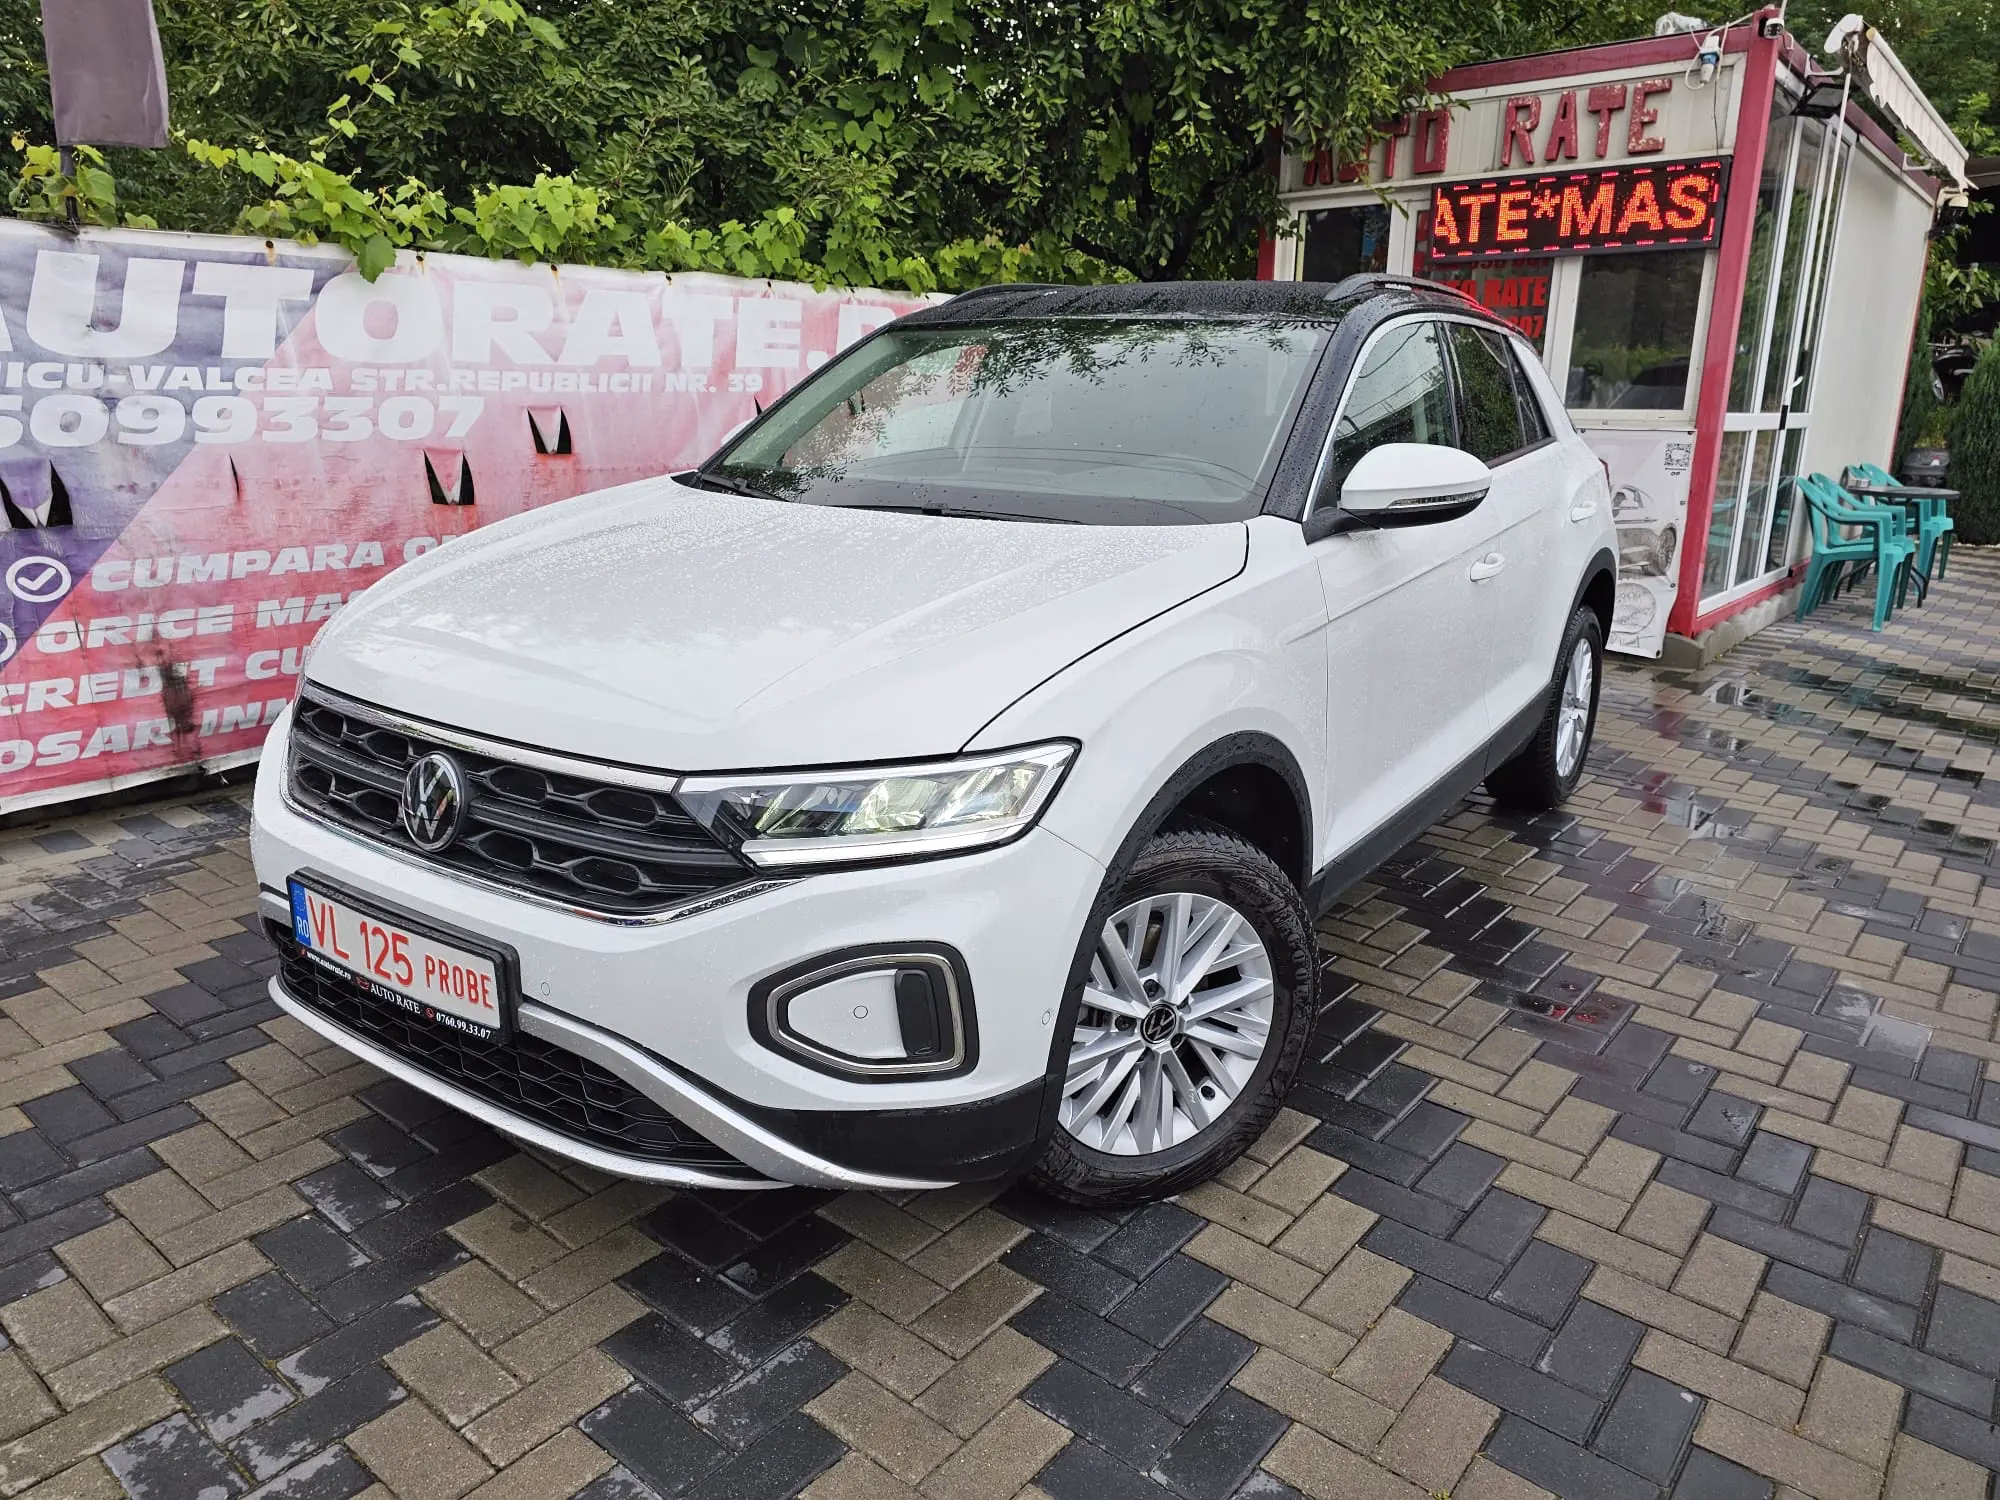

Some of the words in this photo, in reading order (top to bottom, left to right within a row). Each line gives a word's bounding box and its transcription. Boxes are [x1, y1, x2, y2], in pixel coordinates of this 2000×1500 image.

[1502, 78, 1672, 167] RATE
[0, 249, 896, 370] UTORATE.
[1484, 276, 1548, 307] RATE
[0, 361, 334, 392] ICU-VALCEA
[351, 367, 652, 394] STR.REPUBLICII
[665, 373, 717, 394] NR.
[728, 373, 763, 393] 39
[90, 541, 386, 593] CUMPARA
[403, 534, 462, 563] O
[36, 604, 235, 654] ORICE
[296, 915, 310, 939] RO
[307, 894, 350, 960] VL
[359, 920, 414, 988] 125
[424, 953, 495, 1011] PROBE
[370, 983, 396, 1003] AUTO
[396, 996, 421, 1015] RATE
[435, 1012, 492, 1041] 0760.99.33.07
